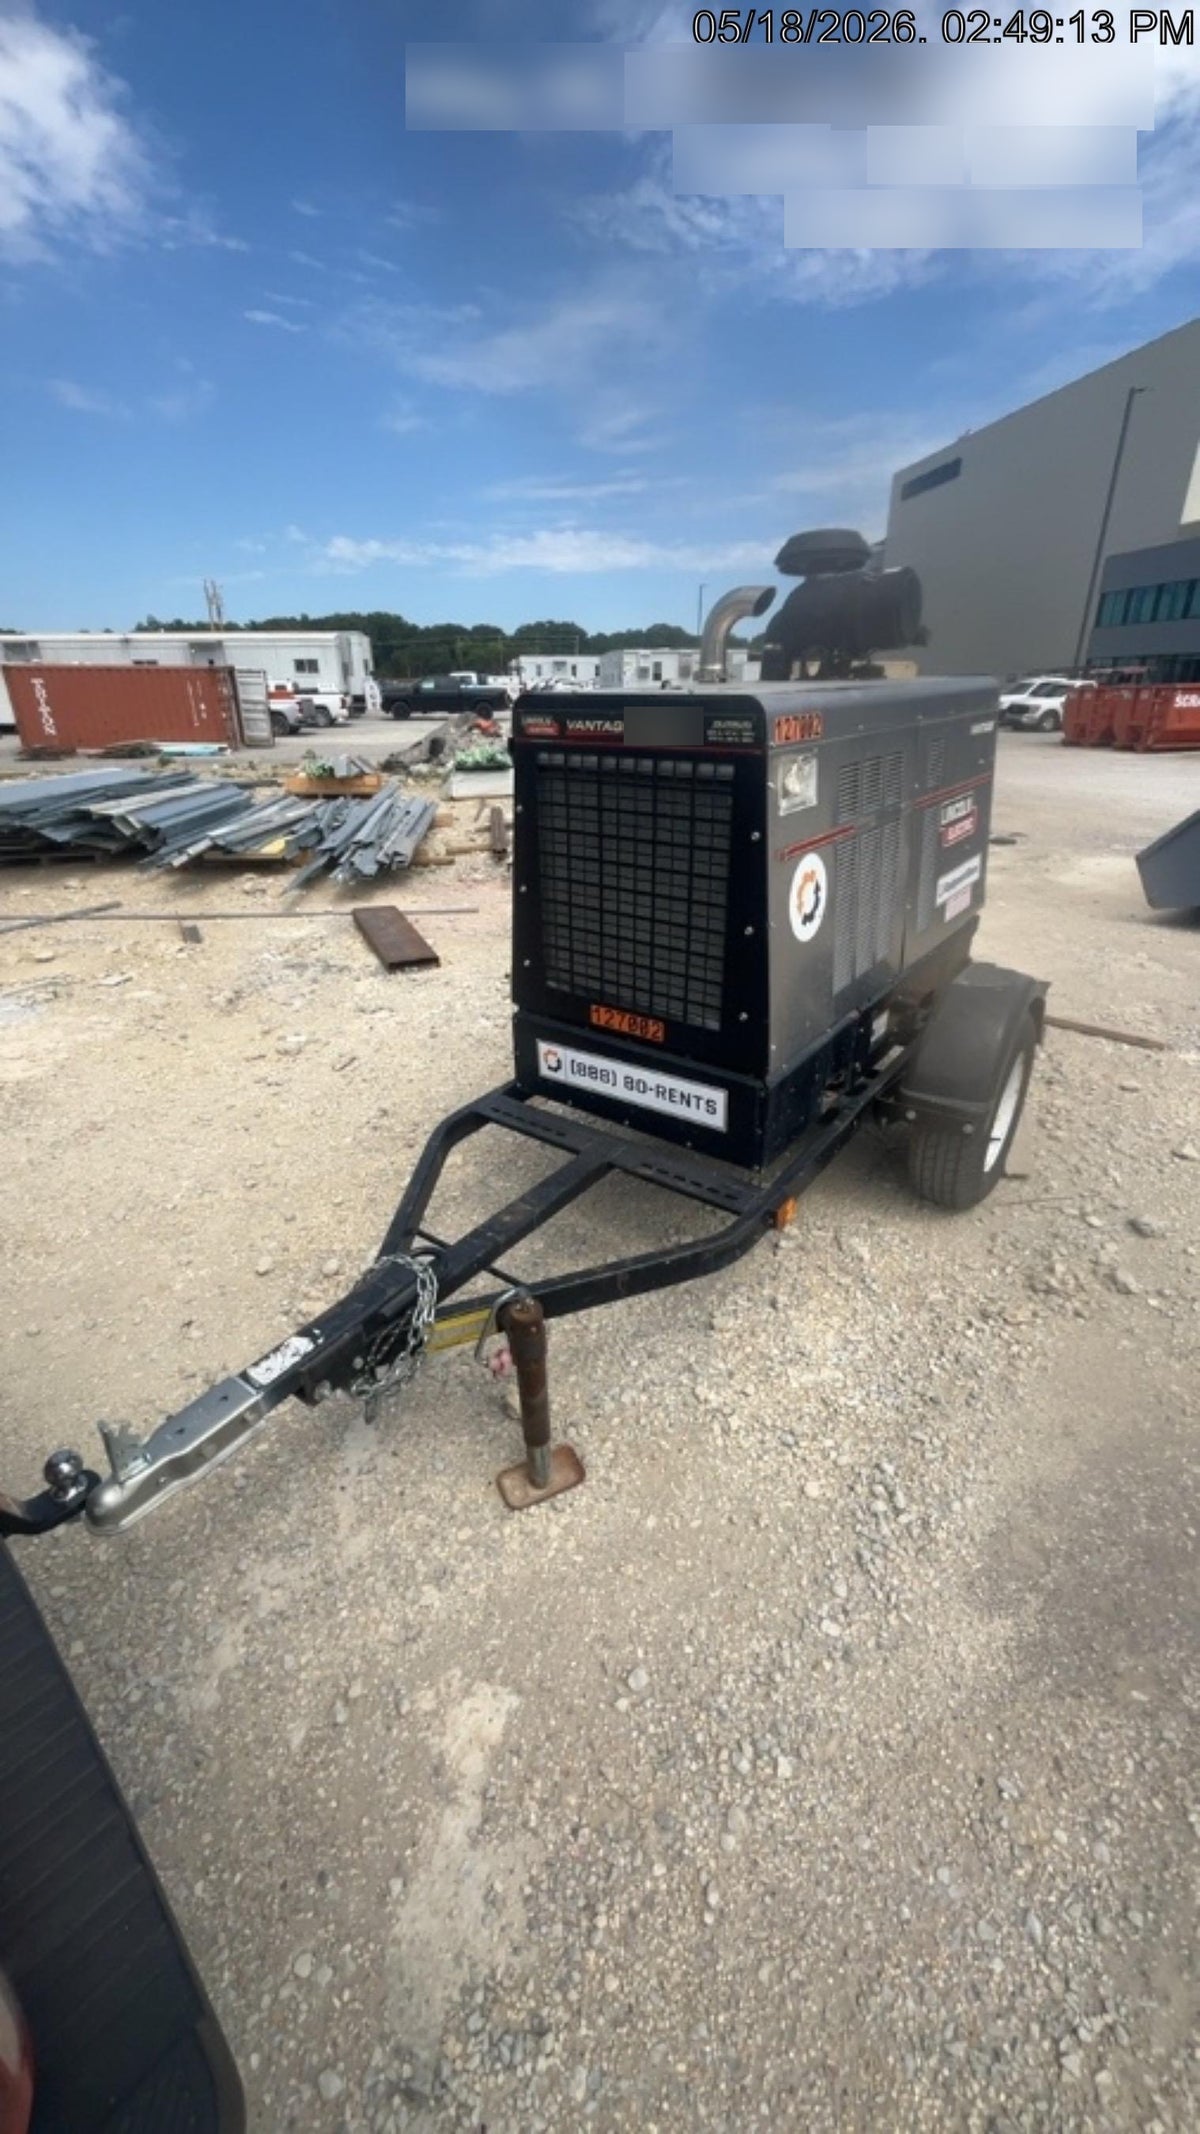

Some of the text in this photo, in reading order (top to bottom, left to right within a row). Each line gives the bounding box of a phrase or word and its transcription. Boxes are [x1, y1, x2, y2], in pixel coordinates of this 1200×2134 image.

[565, 719, 624, 733] VANTAG
[571, 1059, 717, 1115] (888) 80-RENTS
